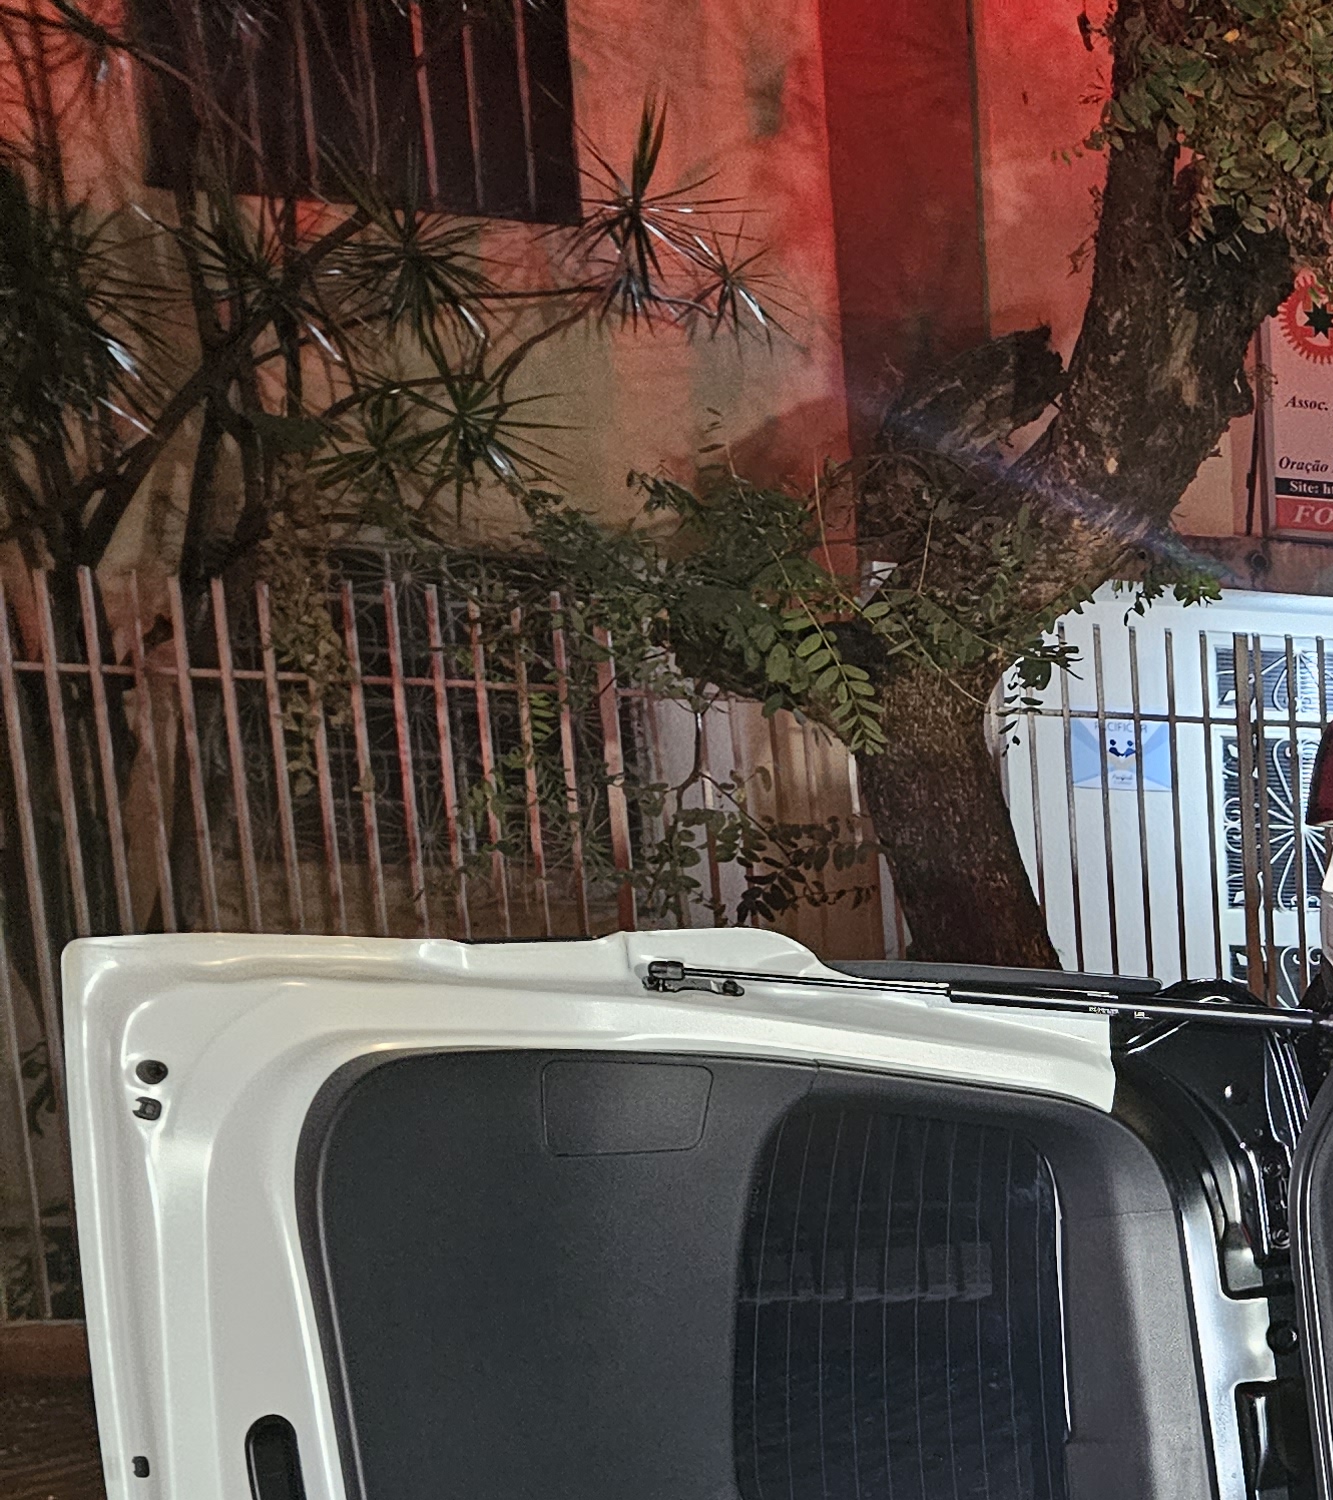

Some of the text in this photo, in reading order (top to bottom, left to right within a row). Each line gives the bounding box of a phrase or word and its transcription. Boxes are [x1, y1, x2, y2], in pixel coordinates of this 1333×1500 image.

[1284, 395, 1329, 412] Assoc.
[1278, 456, 1329, 474] Oração
[1289, 480, 1320, 494] Site:
